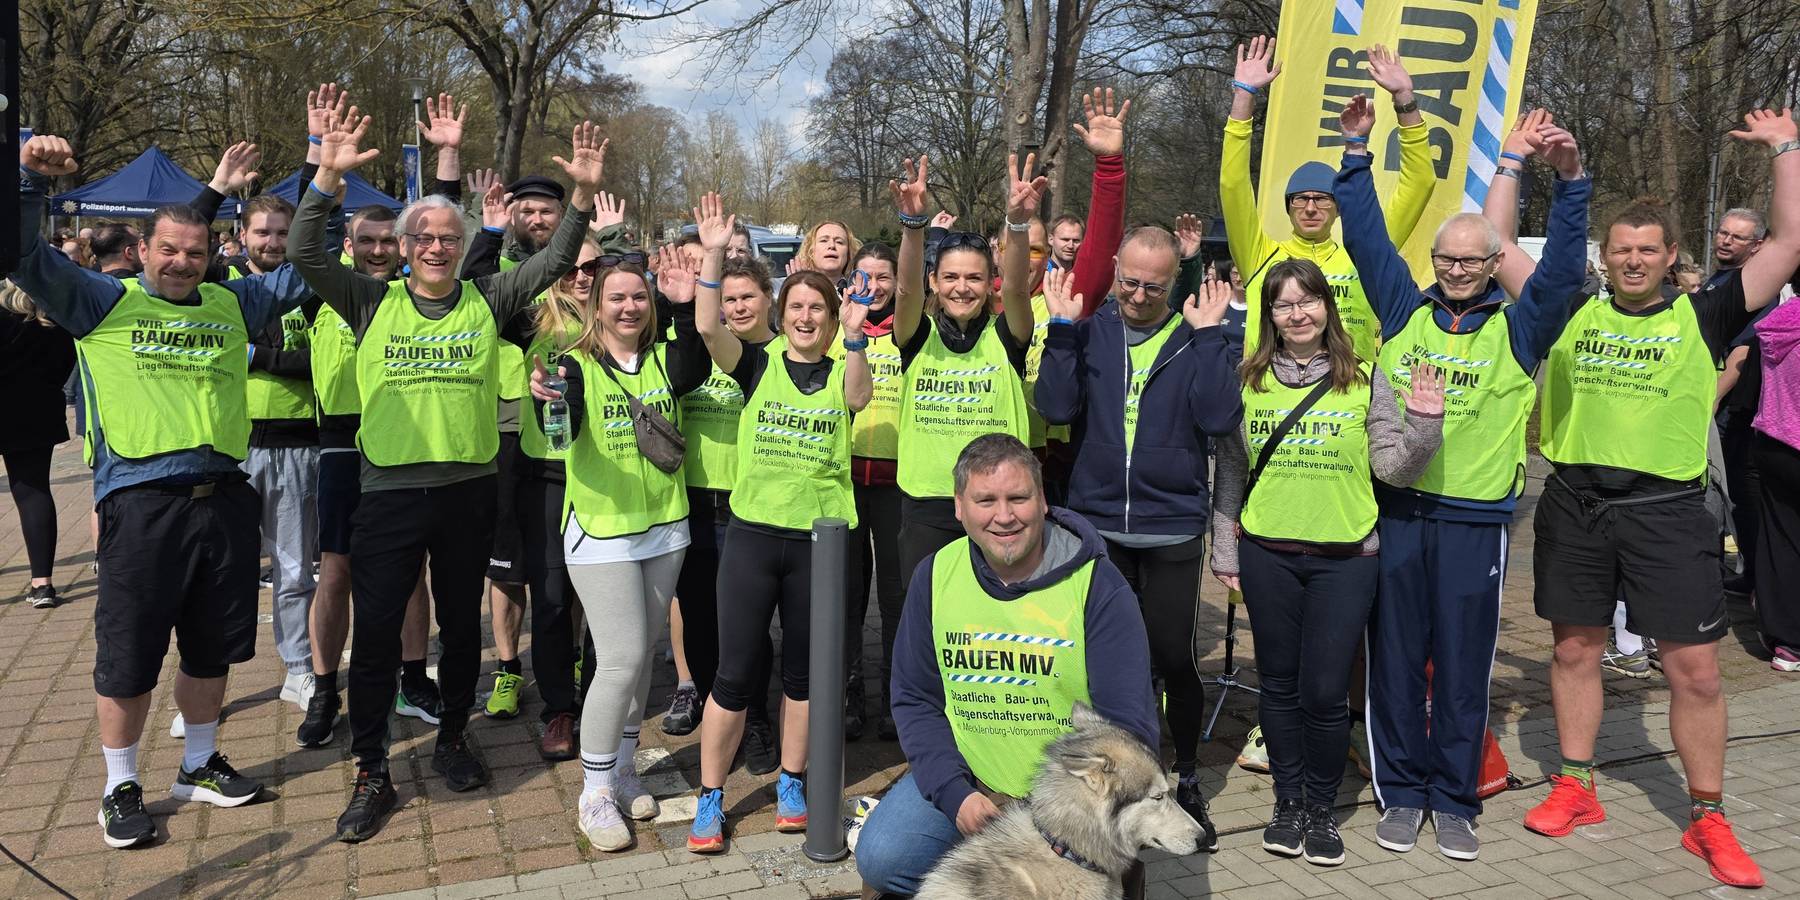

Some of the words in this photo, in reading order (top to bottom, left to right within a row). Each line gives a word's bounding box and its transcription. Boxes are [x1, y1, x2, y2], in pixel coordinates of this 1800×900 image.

[1384, 0, 1484, 180] BAU
[80, 203, 126, 212] Polizeisport
[136, 319, 163, 329] WIR
[131, 330, 197, 348] BAUEN
[200, 334, 224, 348] MV
[390, 334, 411, 344] WIR
[384, 345, 444, 360] BAUEN
[448, 344, 473, 358] MV
[1574, 340, 1631, 359] BAUEN
[385, 368, 426, 377] Staatliche
[455, 367, 470, 375] und
[922, 367, 938, 377] WIR
[1610, 367, 1631, 377] Bau-
[704, 377, 736, 389] UEN
[915, 378, 965, 394] BAUEN
[606, 393, 627, 402] WIR
[764, 400, 783, 410] WIR
[914, 402, 950, 413] Staatliche
[956, 404, 975, 413] Bau-
[977, 405, 993, 414] und
[1255, 409, 1275, 418] WIR
[758, 410, 808, 430] BAUEN
[812, 419, 837, 435] MV
[914, 414, 1008, 428] Liegenschaftsverwaltung
[755, 434, 792, 446] Staatliche
[798, 440, 817, 450] Bau-
[1298, 447, 1319, 455] Bau-
[1322, 449, 1340, 458] und
[1266, 459, 1354, 473] genschaftsverwaltung
[945, 631, 972, 646] WIR
[942, 648, 1015, 672] BAUEN
[951, 689, 996, 704] Staatliche
[1005, 693, 1030, 705] Bau-
